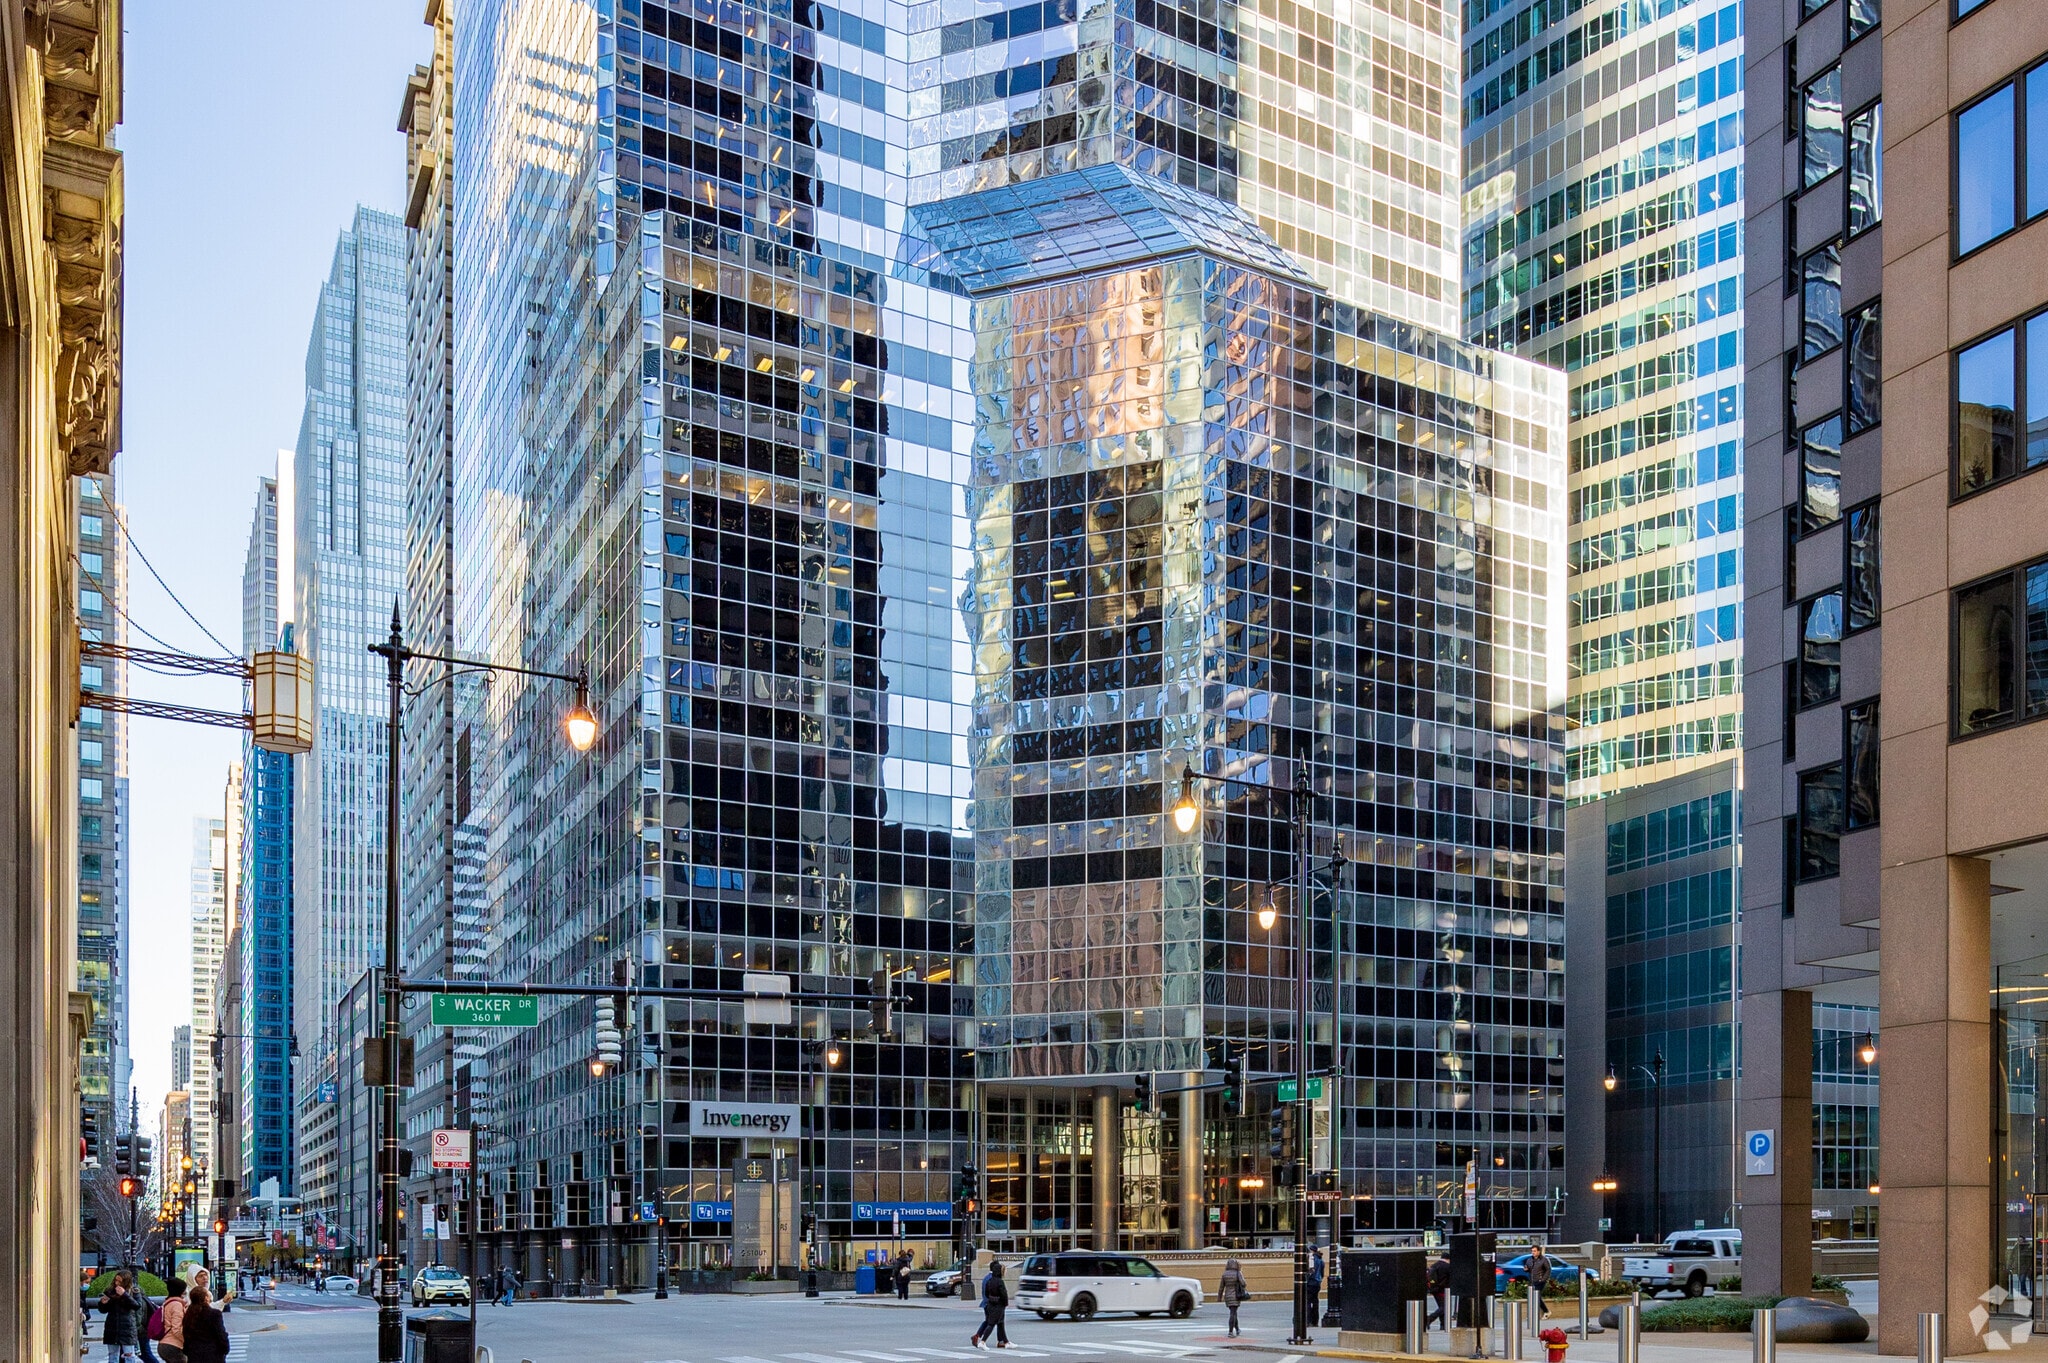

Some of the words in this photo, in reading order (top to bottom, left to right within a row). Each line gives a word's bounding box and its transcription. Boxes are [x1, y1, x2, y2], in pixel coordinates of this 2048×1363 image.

[439, 998, 446, 1007] S
[454, 998, 511, 1011] WACKER
[518, 999, 532, 1008] DR
[472, 1013, 490, 1022] 360
[493, 1013, 501, 1022] W
[702, 1108, 791, 1132] Invenergy
[1755, 1137, 1766, 1153] P
[716, 1208, 733, 1216] FIFT
[875, 1207, 896, 1216] FIFT
[900, 1207, 925, 1216] THIRD
[926, 1207, 949, 1216] BANK
